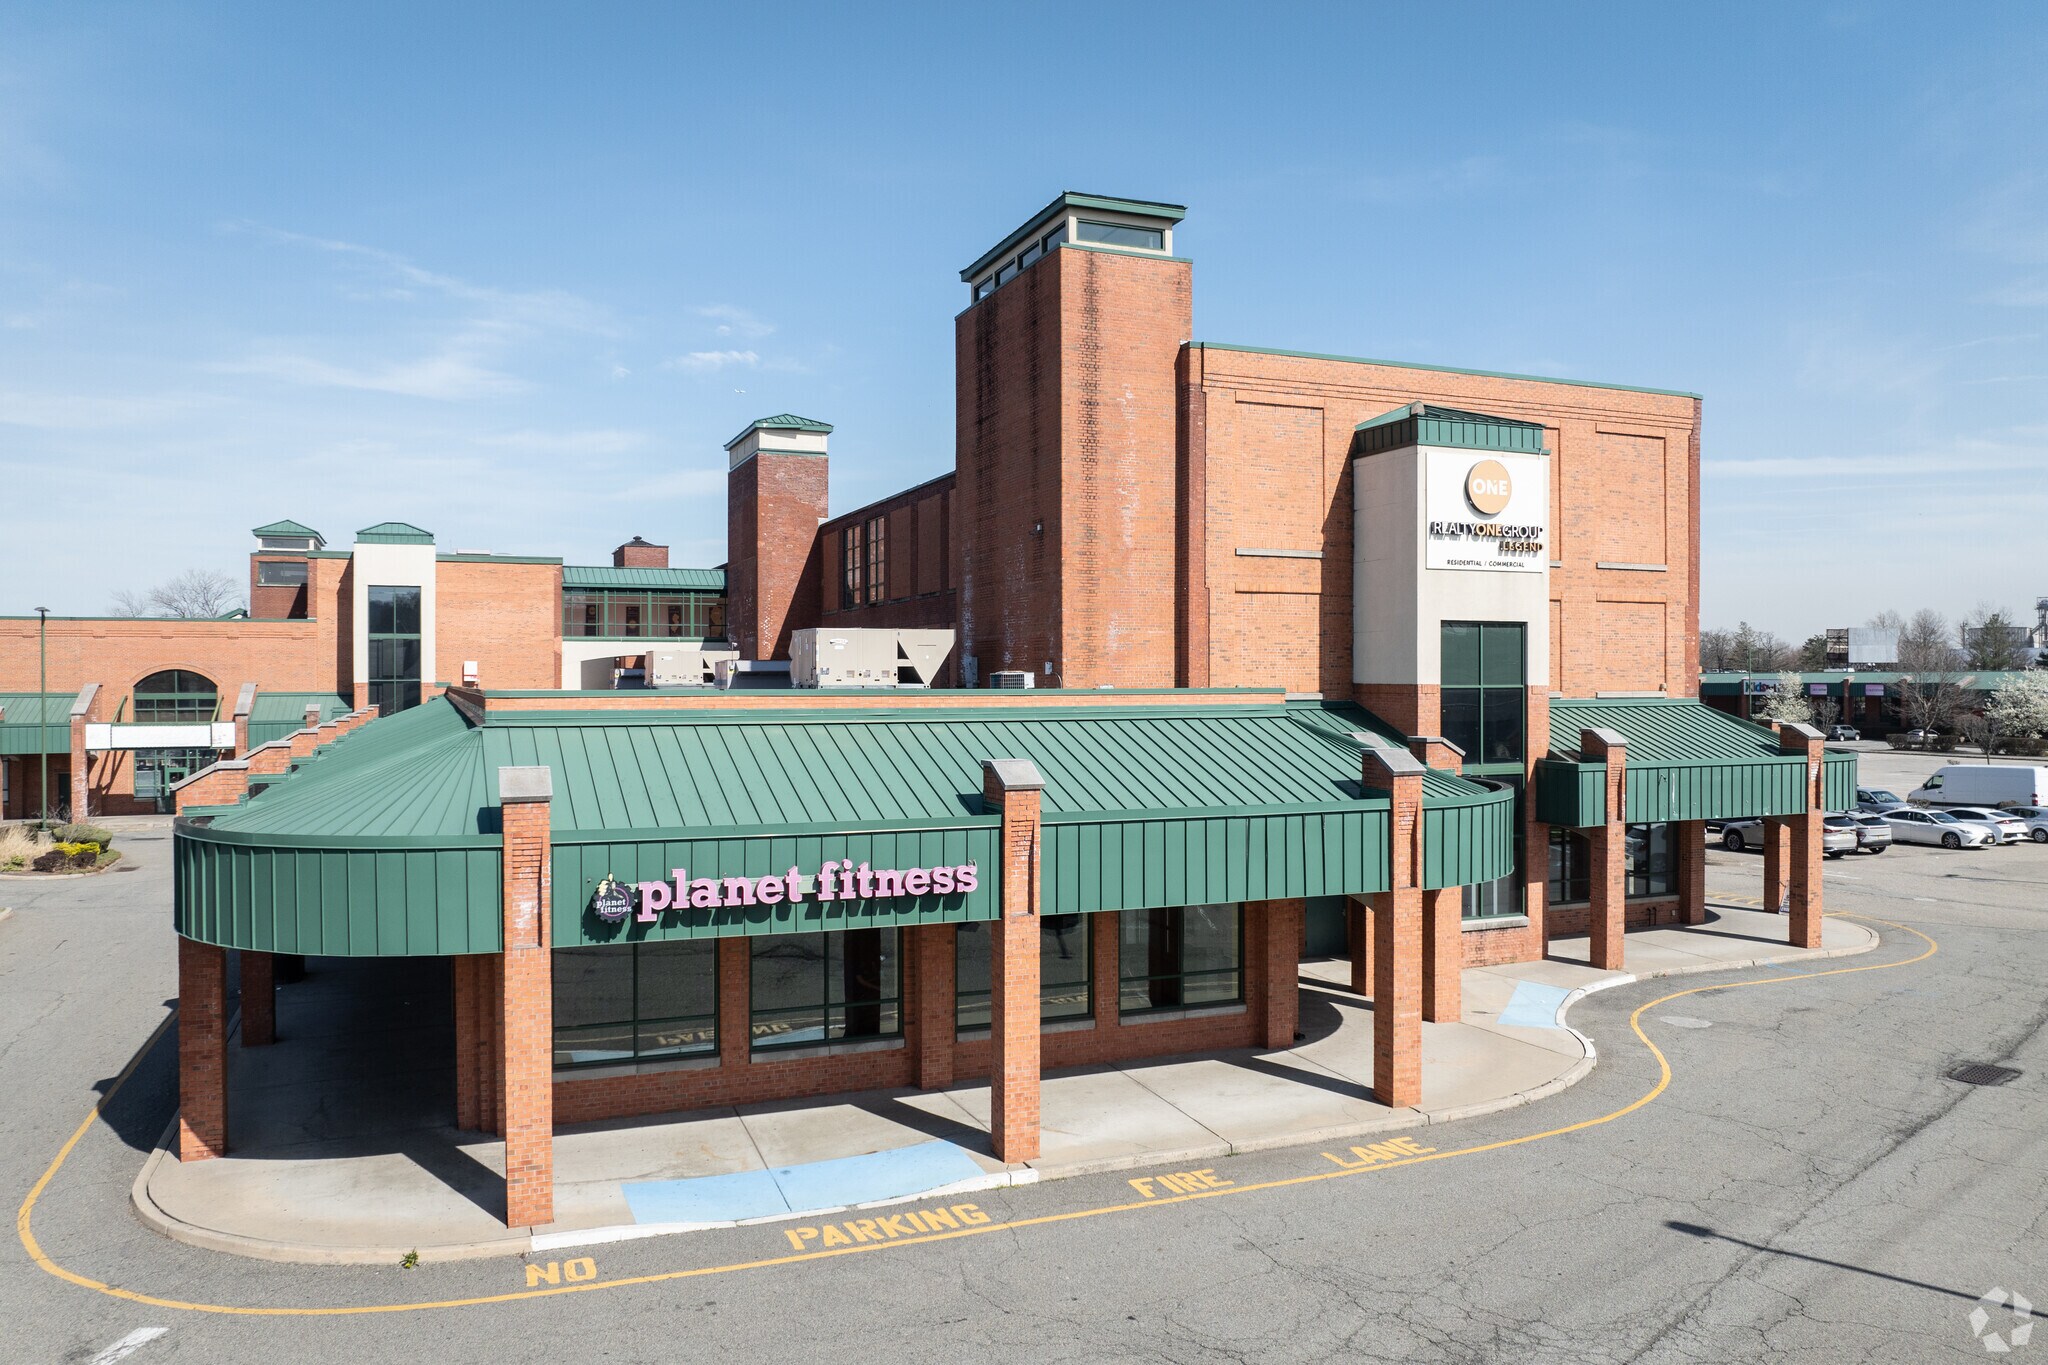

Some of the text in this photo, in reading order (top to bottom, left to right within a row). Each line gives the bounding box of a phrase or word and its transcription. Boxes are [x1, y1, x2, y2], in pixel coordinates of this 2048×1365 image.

[1472, 478, 1508, 496] ONE
[1502, 541, 1544, 553] LEGEND
[1489, 560, 1525, 568] COMMERCIAL
[637, 859, 978, 922] planet fitness
[596, 899, 627, 909] planet
[600, 905, 632, 914] fitness
[525, 1136, 1437, 1288] NO PARKING FIRE LANE
